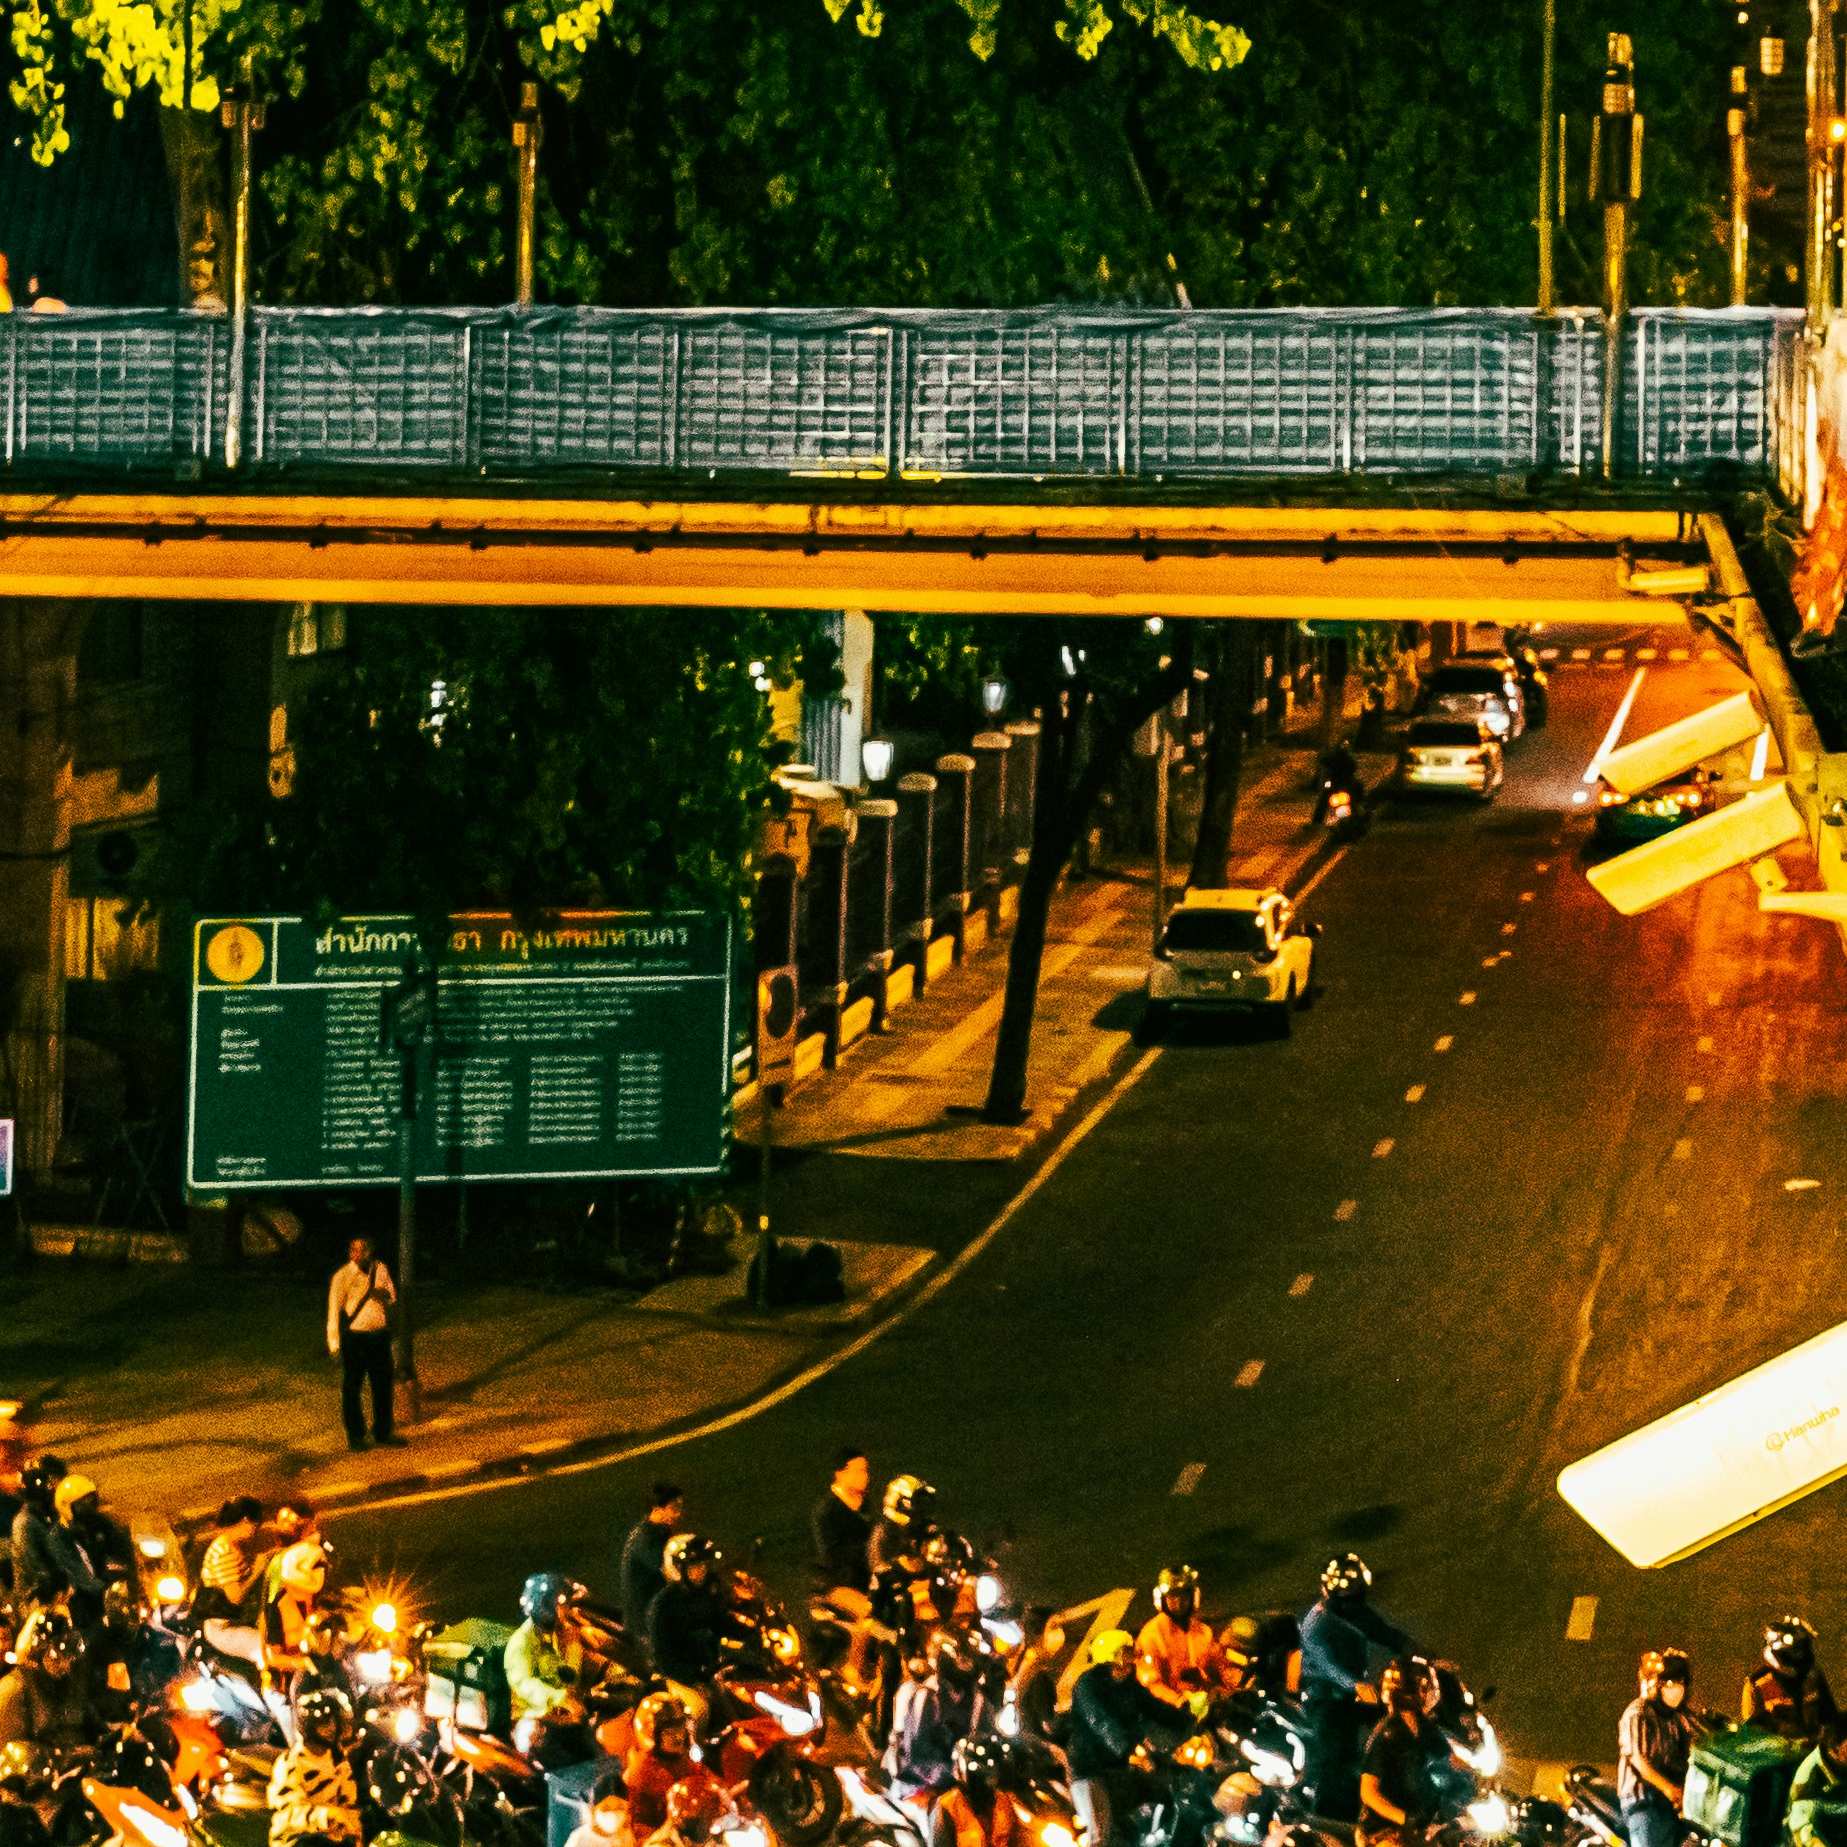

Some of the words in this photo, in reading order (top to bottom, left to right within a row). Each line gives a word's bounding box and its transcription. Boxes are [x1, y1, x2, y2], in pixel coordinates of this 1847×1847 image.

[501, 927, 688, 960] กรุงเทพมหานคร
[1783, 1406, 1840, 1441] Hanwha
